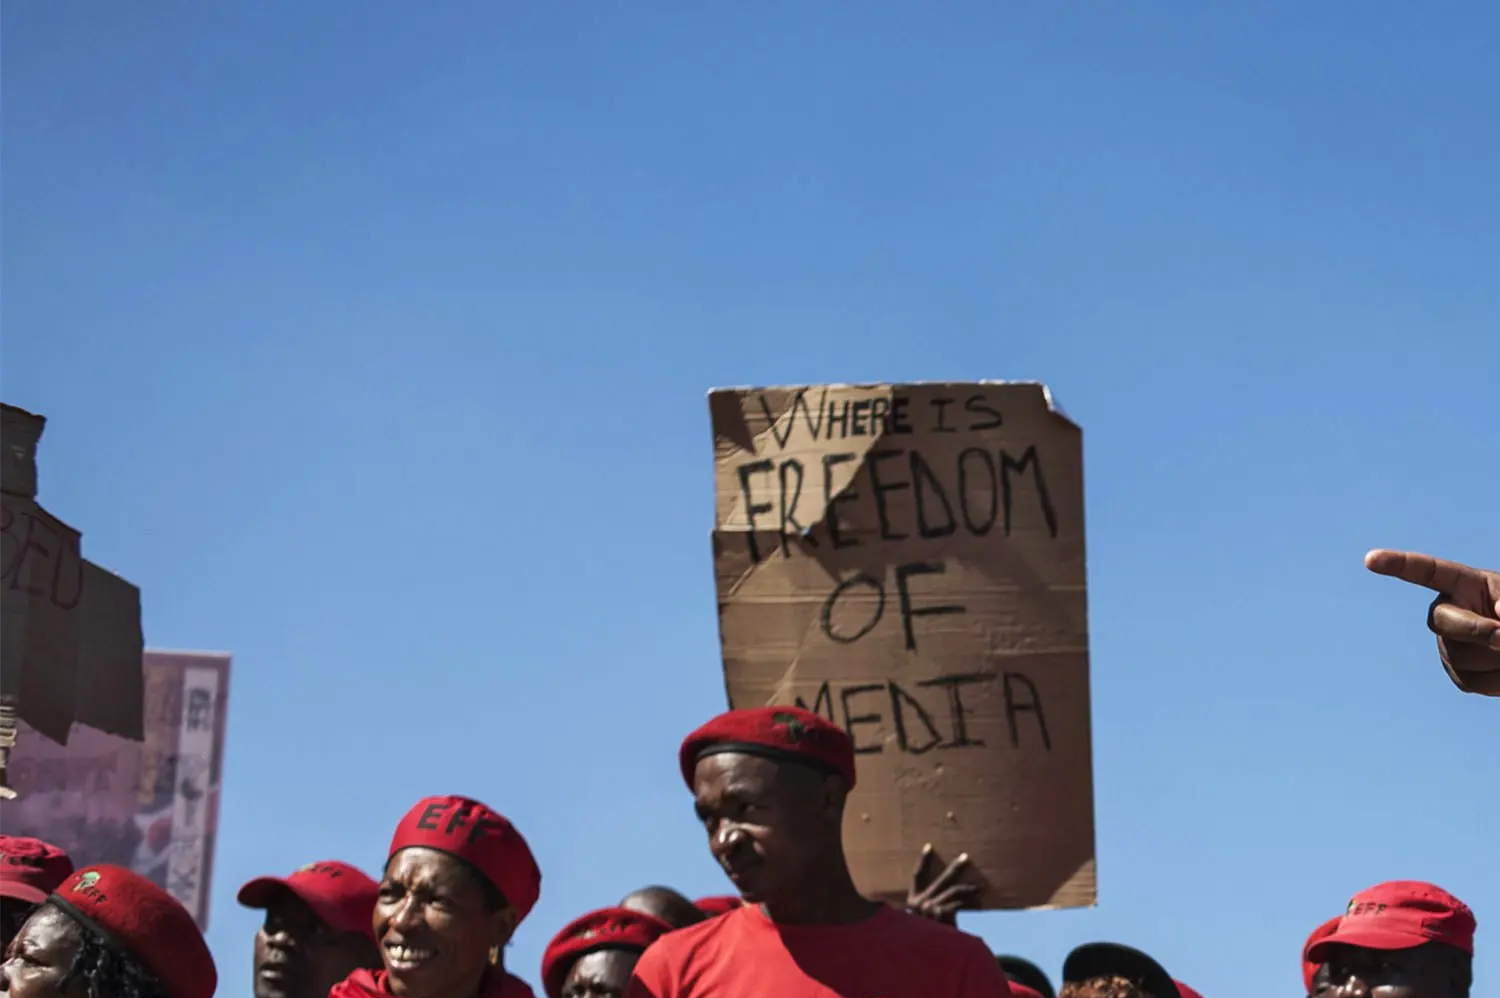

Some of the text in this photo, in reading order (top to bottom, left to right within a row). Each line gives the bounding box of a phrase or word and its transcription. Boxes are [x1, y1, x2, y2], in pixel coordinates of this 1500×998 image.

[761, 390, 1003, 448] WHERE IS
[738, 445, 1058, 563] FREEDOM
[821, 562, 966, 651] OF
[417, 803, 503, 846] EFF
